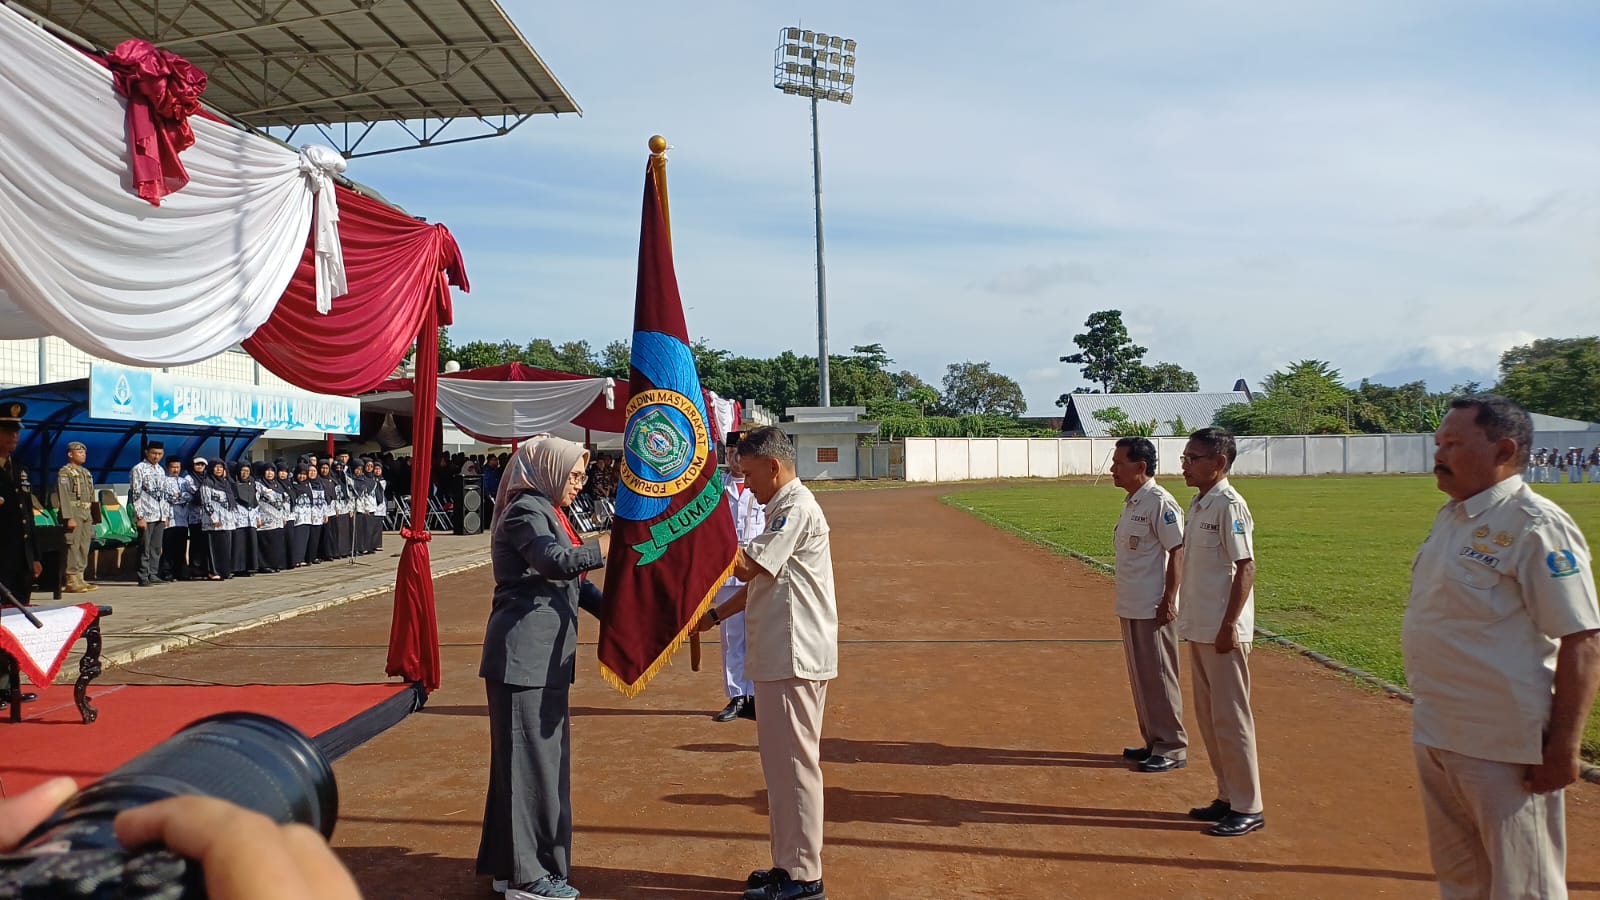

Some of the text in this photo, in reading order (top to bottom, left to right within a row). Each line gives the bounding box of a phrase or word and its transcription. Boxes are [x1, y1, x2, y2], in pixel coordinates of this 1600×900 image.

[256, 395, 289, 423] TIRTA
[636, 393, 655, 407] DINI
[657, 392, 706, 447] MASYARAKAT
[630, 476, 666, 494] FORUM
[675, 456, 705, 490] FKDM
[667, 481, 720, 535] LUMAJ
